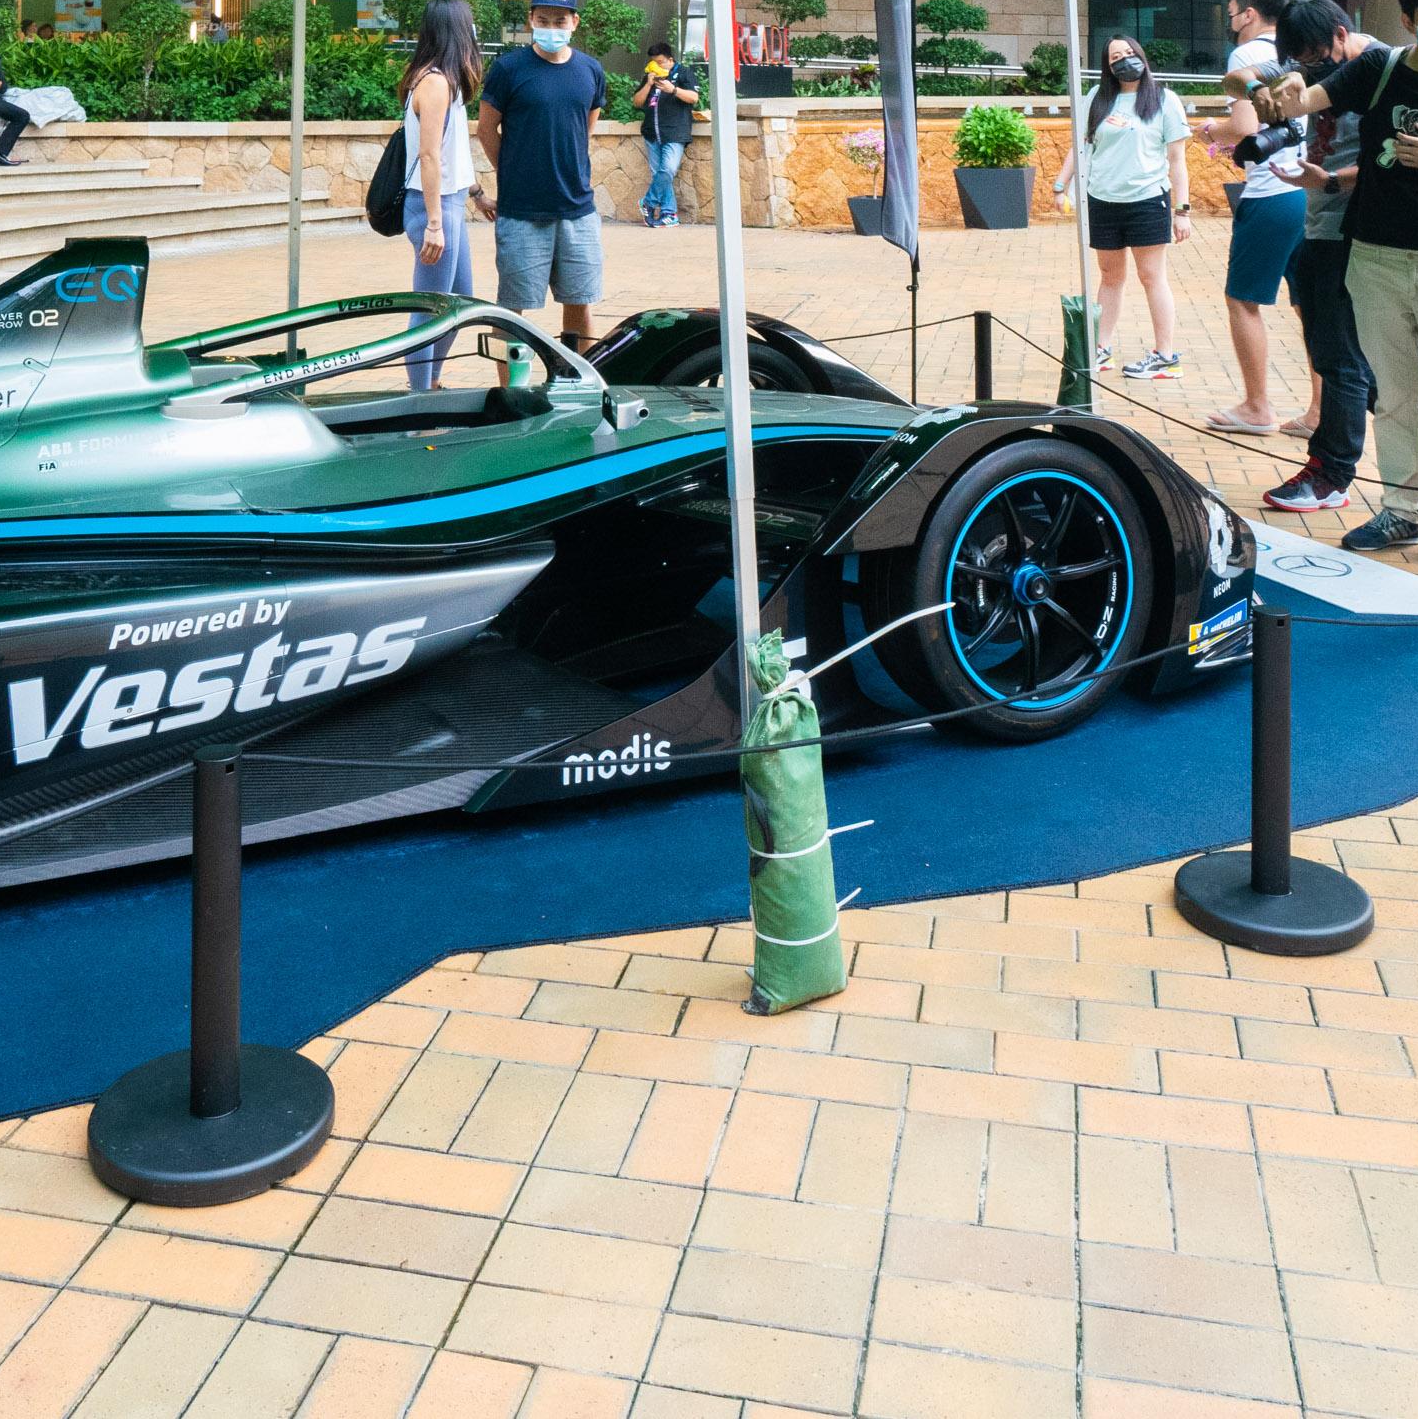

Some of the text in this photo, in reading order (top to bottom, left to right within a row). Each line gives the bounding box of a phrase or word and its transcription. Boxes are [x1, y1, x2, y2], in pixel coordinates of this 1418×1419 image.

[55, 264, 140, 303] EQ
[29, 309, 59, 327] 02
[263, 351, 362, 385] END RACISM
[37, 442, 73, 459] ABB
[1110, 572, 1118, 602] RACING
[1213, 578, 1231, 599] NEOM
[108, 598, 293, 650] Powered by
[8, 616, 428, 766] Vestas
[562, 732, 672, 786] modis
